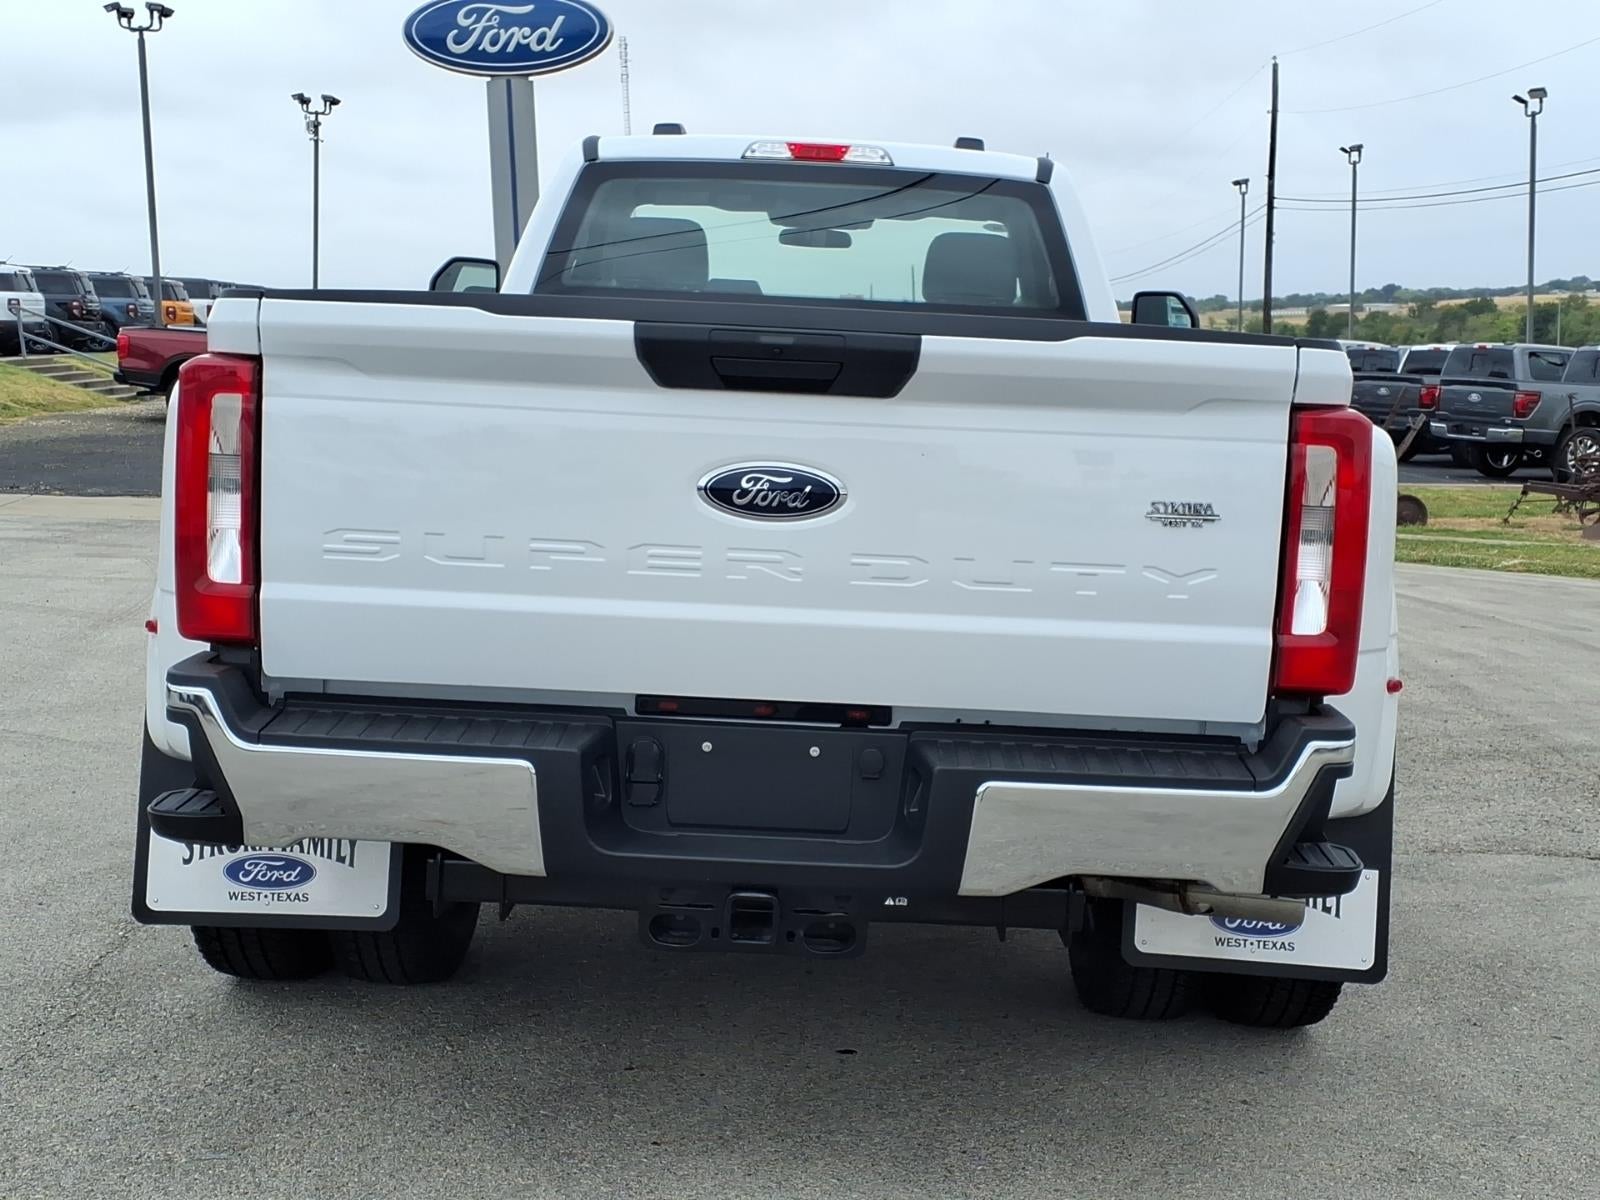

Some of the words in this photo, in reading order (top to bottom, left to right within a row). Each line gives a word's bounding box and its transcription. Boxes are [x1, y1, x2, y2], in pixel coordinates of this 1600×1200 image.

[446, 3, 566, 54] Ford
[732, 473, 813, 509] Ford
[323, 527, 803, 582] SUPER
[850, 553, 1218, 599] DUTY
[239, 859, 302, 883] Ford
